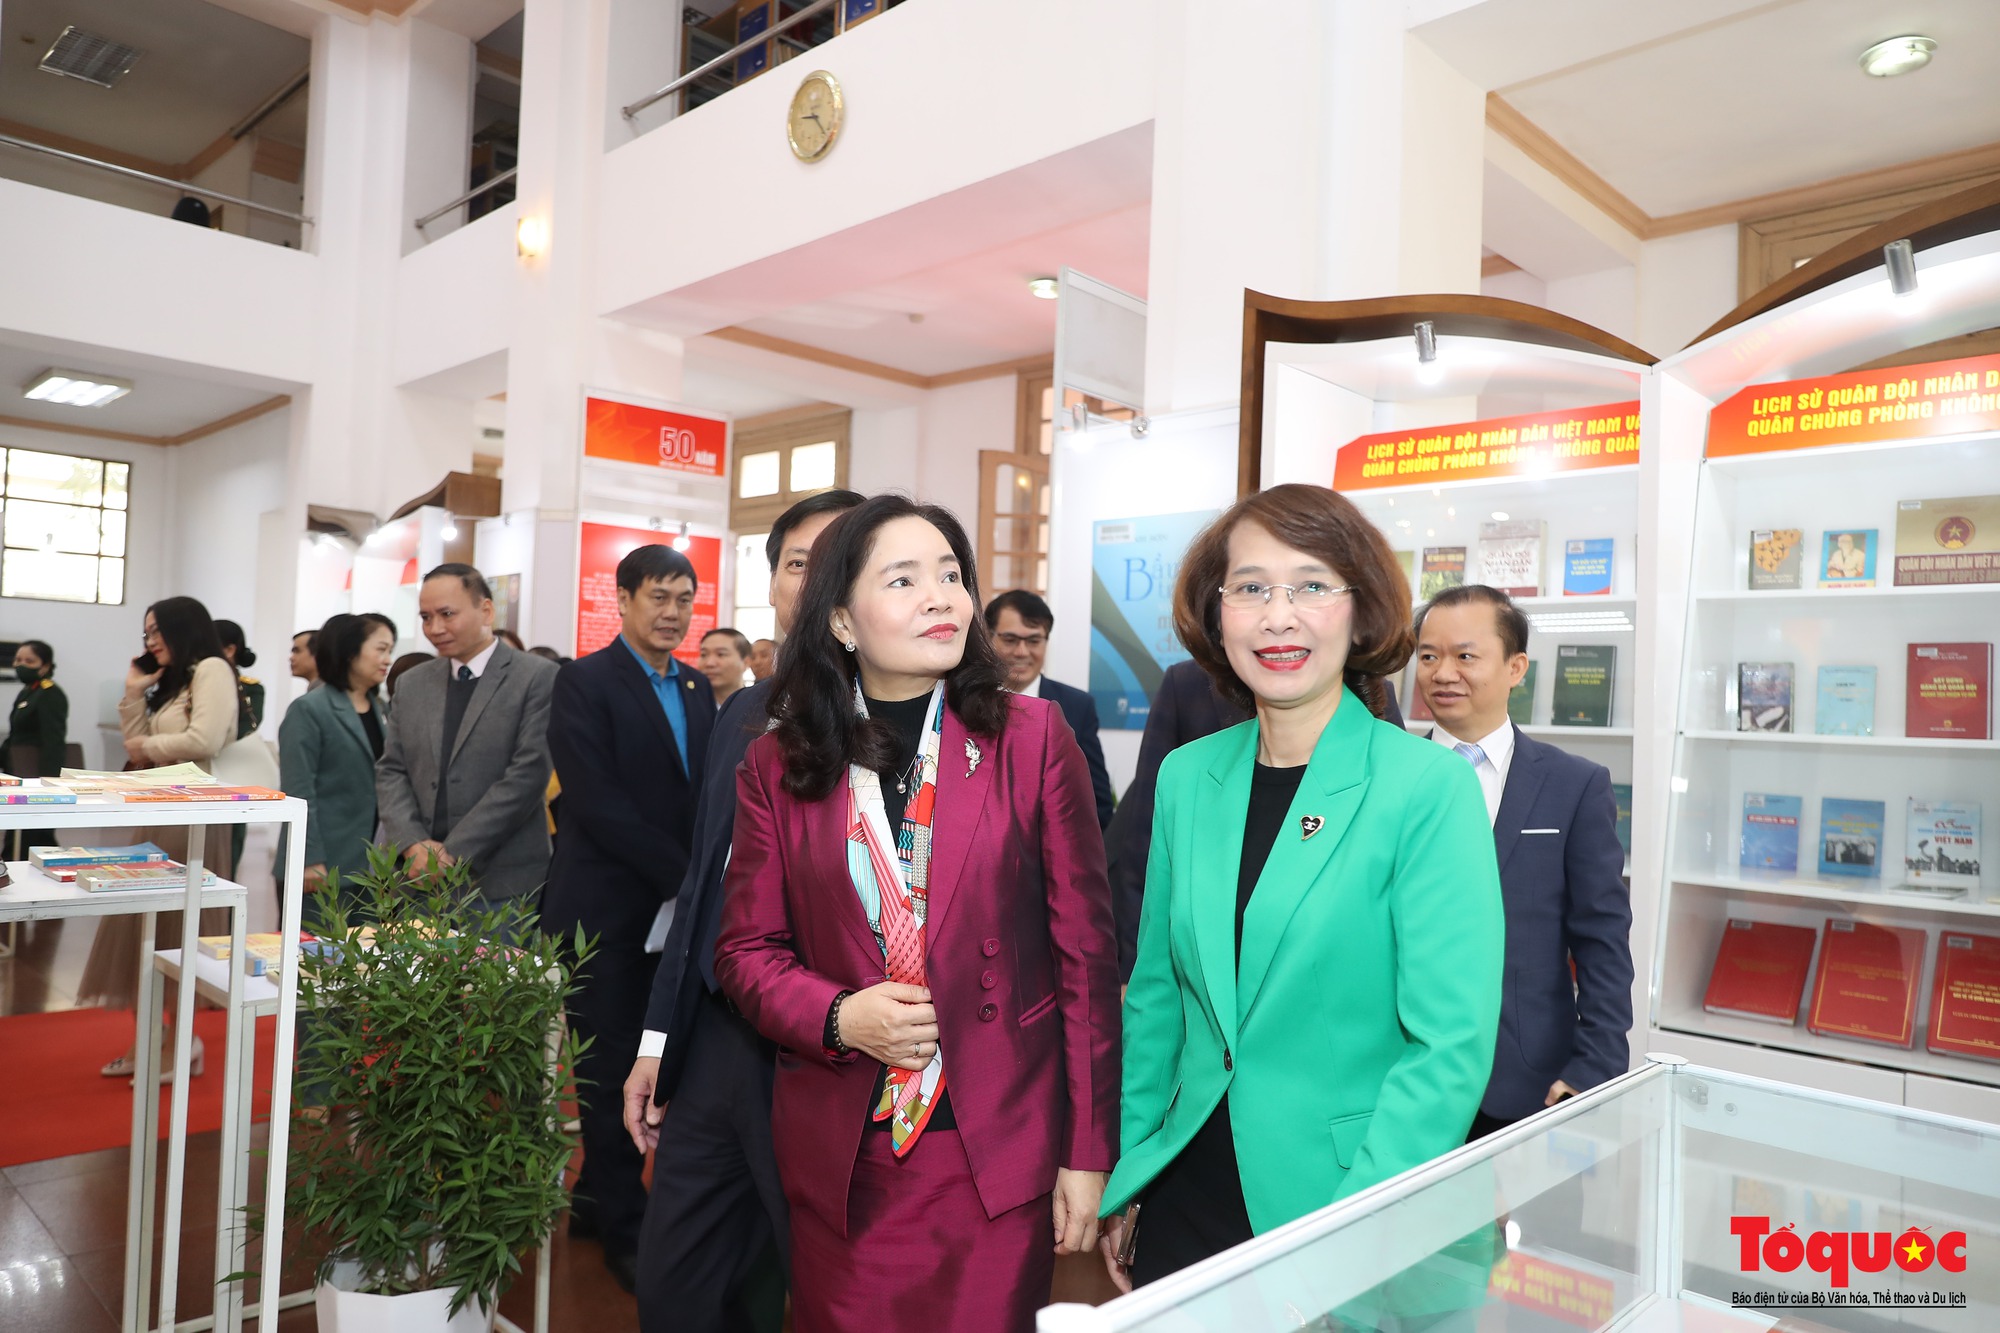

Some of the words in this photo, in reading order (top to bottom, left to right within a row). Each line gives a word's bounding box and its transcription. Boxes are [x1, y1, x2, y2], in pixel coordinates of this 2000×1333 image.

[1753, 395, 1792, 417] LỊCH
[1797, 387, 1824, 410] SỬ
[1827, 384, 1878, 407] QUÂN
[1883, 378, 1918, 402] ĐỘI
[1924, 371, 1978, 396] NHÂN
[1985, 370, 2000, 388] D
[1367, 443, 1394, 461] LỊCH
[1397, 437, 1416, 456] SỬ
[1417, 435, 1451, 454] QUÂN
[1454, 431, 1478, 451] ĐỘI
[1480, 427, 1517, 447] NHÂN
[1520, 423, 1549, 443] DÂN
[1552, 419, 1583, 440] VIỆT
[1586, 416, 1621, 436] NAM
[1747, 415, 1794, 437] QUÂN
[1800, 407, 1862, 431] CHỦNG
[1868, 401, 1933, 424] PHÒNG
[659, 426, 696, 465] 50
[1362, 459, 1395, 478] QUÂN
[1442, 450, 1487, 470] PHÒNG
[1489, 445, 1536, 466] KHÔNG
[1552, 439, 1601, 459] KHÔNG
